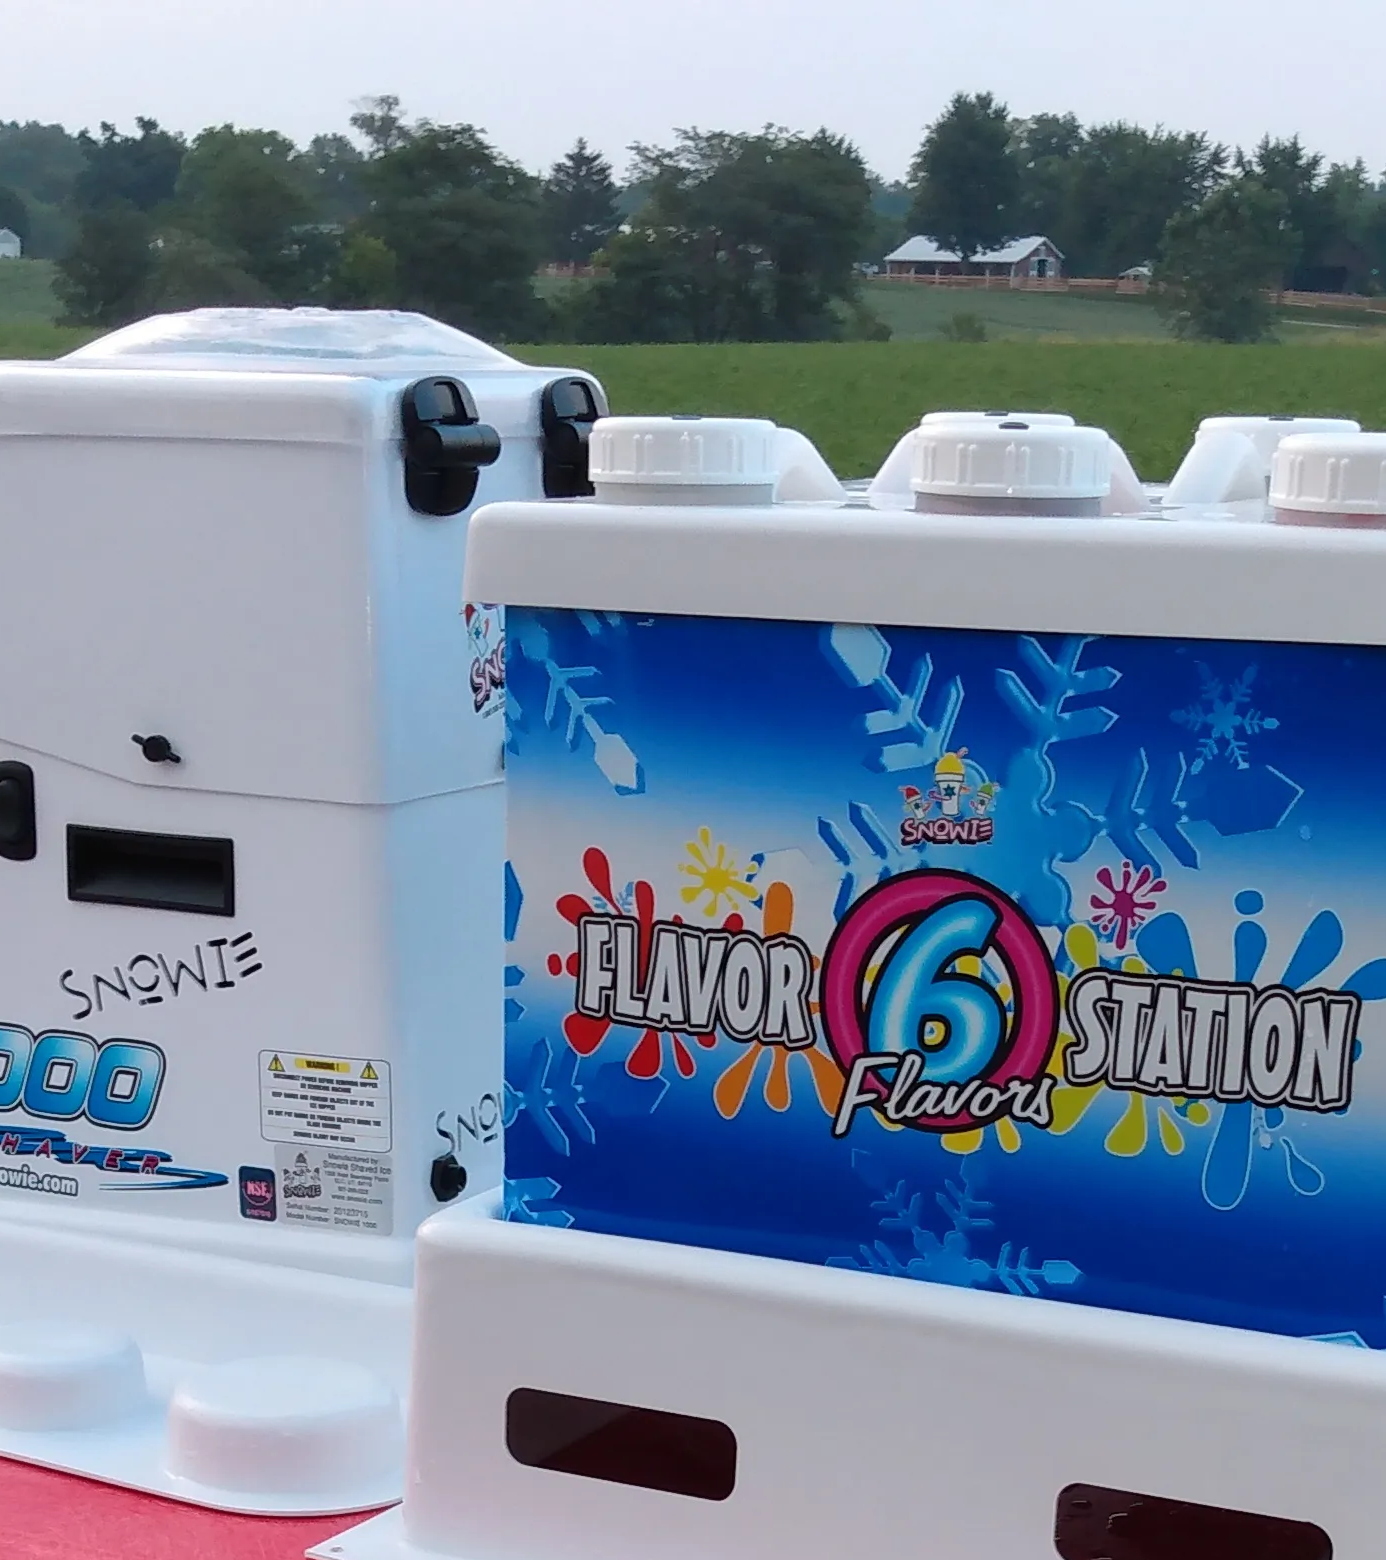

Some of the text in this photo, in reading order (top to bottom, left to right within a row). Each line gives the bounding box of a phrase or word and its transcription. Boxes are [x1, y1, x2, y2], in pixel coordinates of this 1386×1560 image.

[900, 817, 993, 846] SNOWIE
[59, 931, 263, 1020] SNOWIE
[578, 890, 1361, 1112] FLAVOR 6 STATION
[832, 1051, 1053, 1138] Flavors
